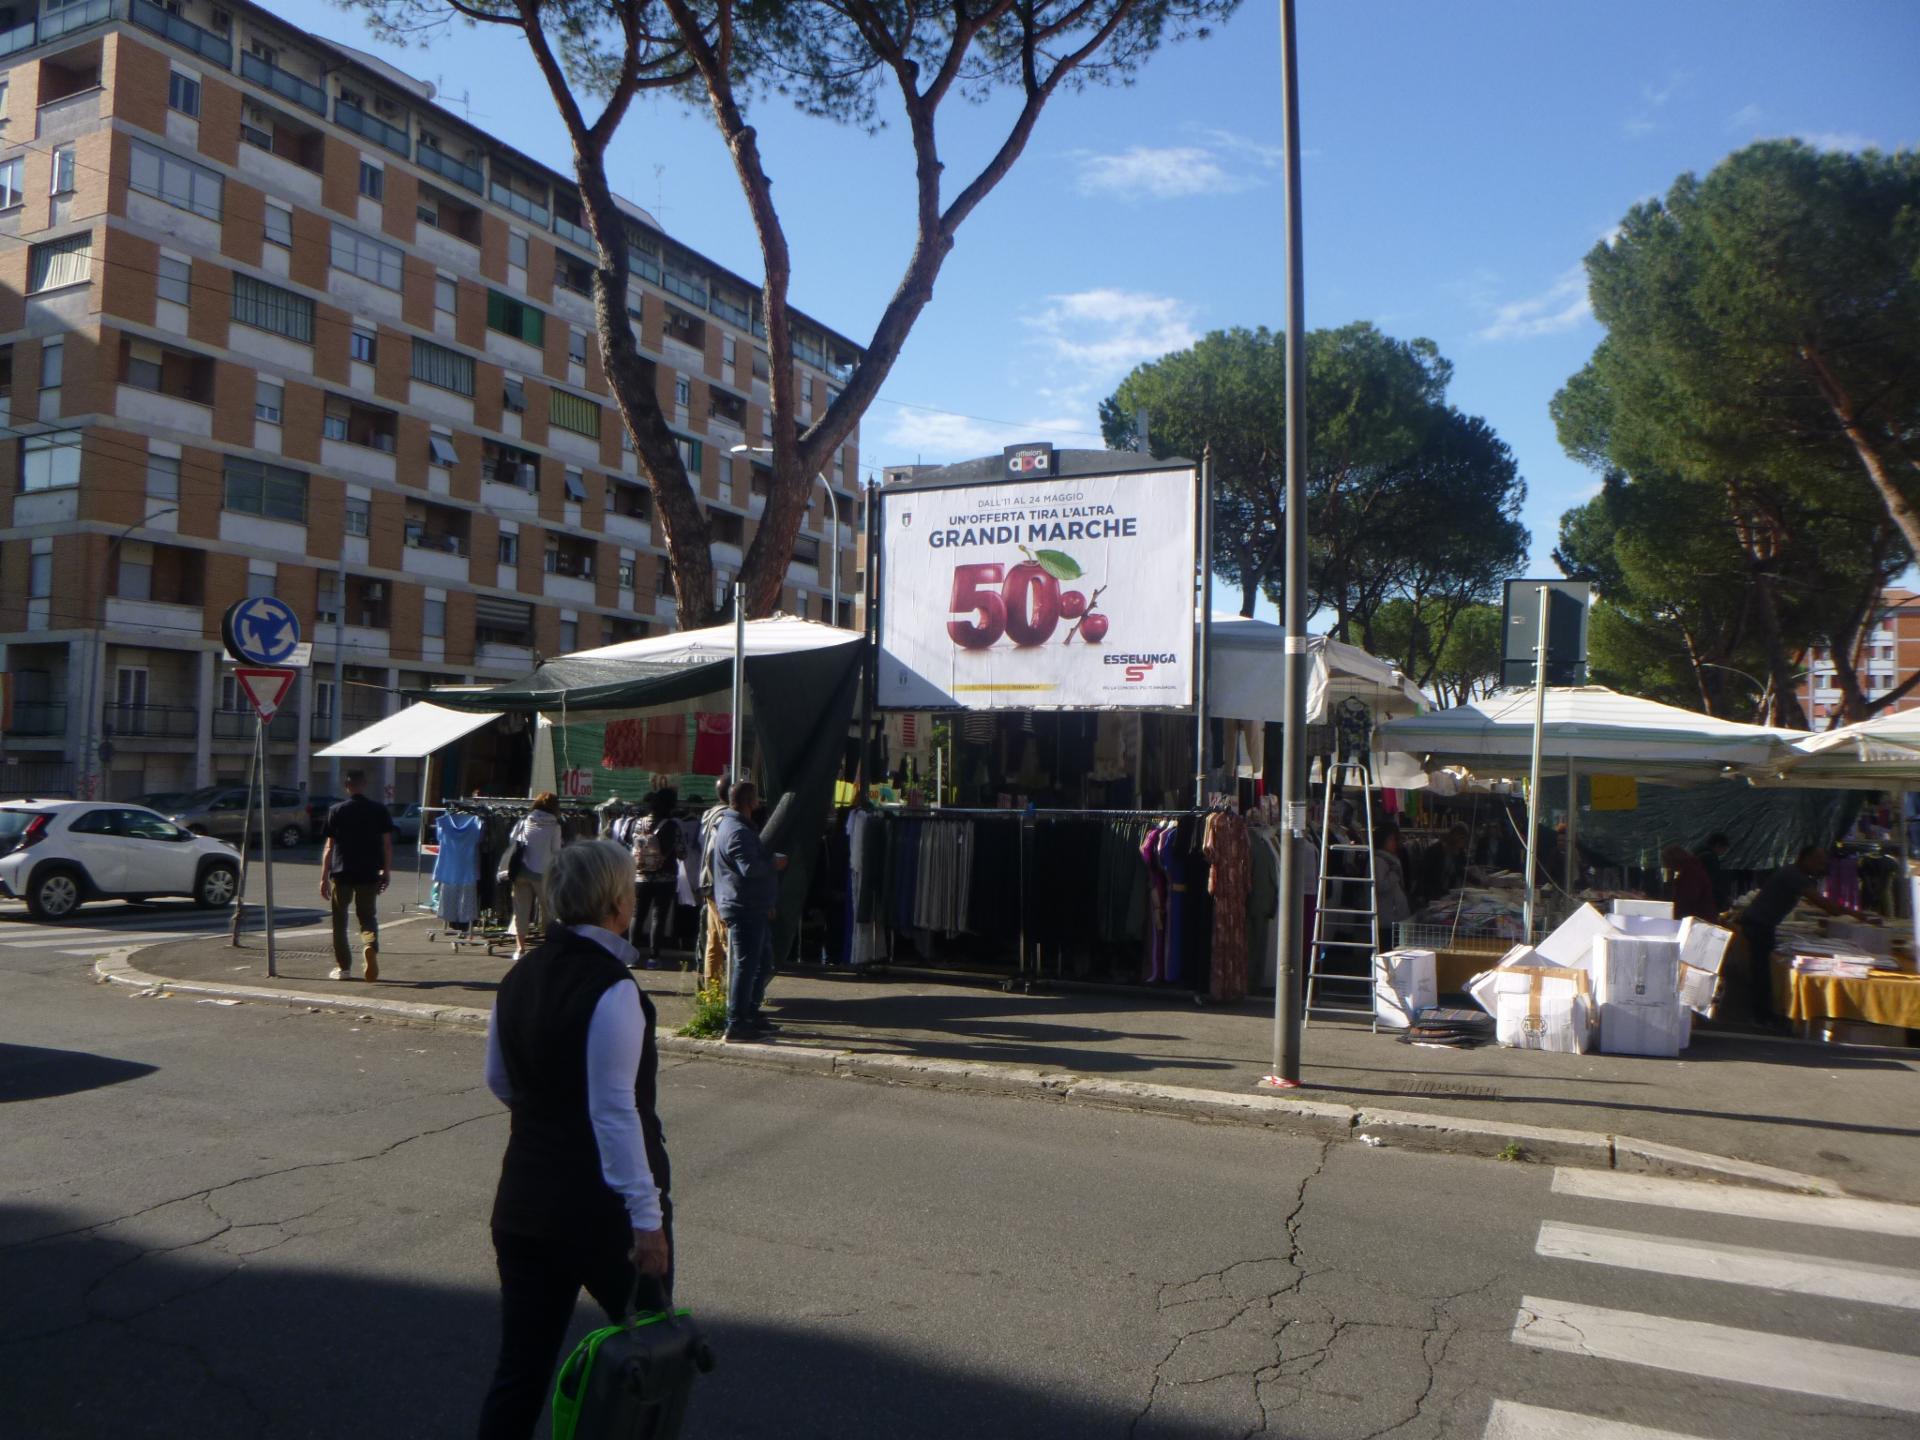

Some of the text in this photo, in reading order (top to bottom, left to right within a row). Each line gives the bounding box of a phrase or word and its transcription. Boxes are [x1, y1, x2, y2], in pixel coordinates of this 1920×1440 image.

[1009, 455, 1048, 472] apa
[978, 492, 1084, 508] DALL'11 AL 24 MAGGIO
[949, 505, 1115, 525] UN'OFFERTA TIRA L'ALTRA
[929, 517, 1137, 548] GRANDI MARCHE
[1103, 654, 1177, 664] ESSELUNGA
